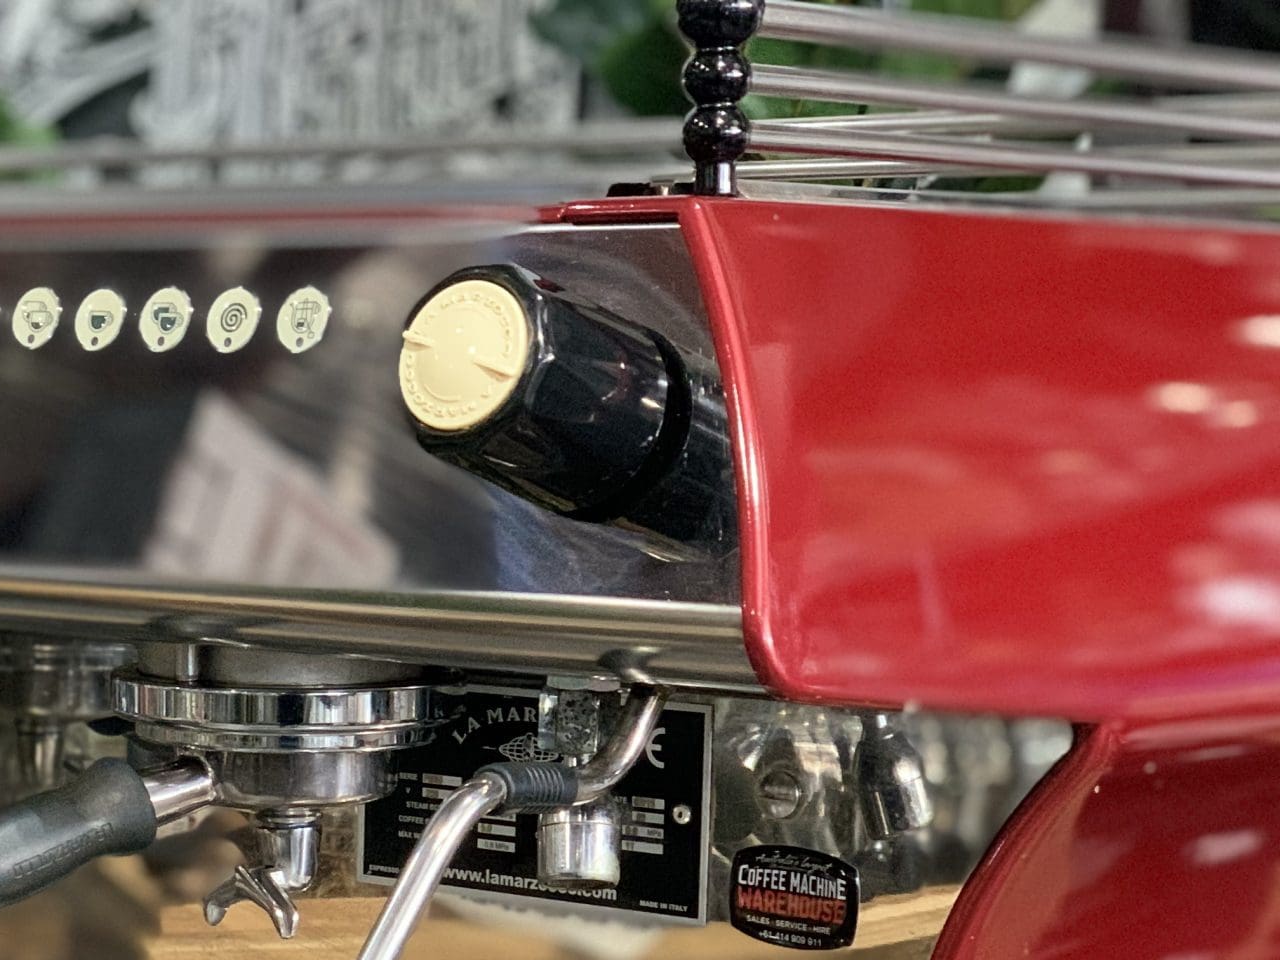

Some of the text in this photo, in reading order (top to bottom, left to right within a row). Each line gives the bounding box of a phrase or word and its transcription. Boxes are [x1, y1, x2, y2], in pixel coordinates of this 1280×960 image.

[451, 716, 481, 745] LA
[738, 864, 847, 900] COFFEE MACHINE
[736, 885, 847, 925] WAREHOUSE
[746, 915, 831, 935] SALES SERVICE HIRE
